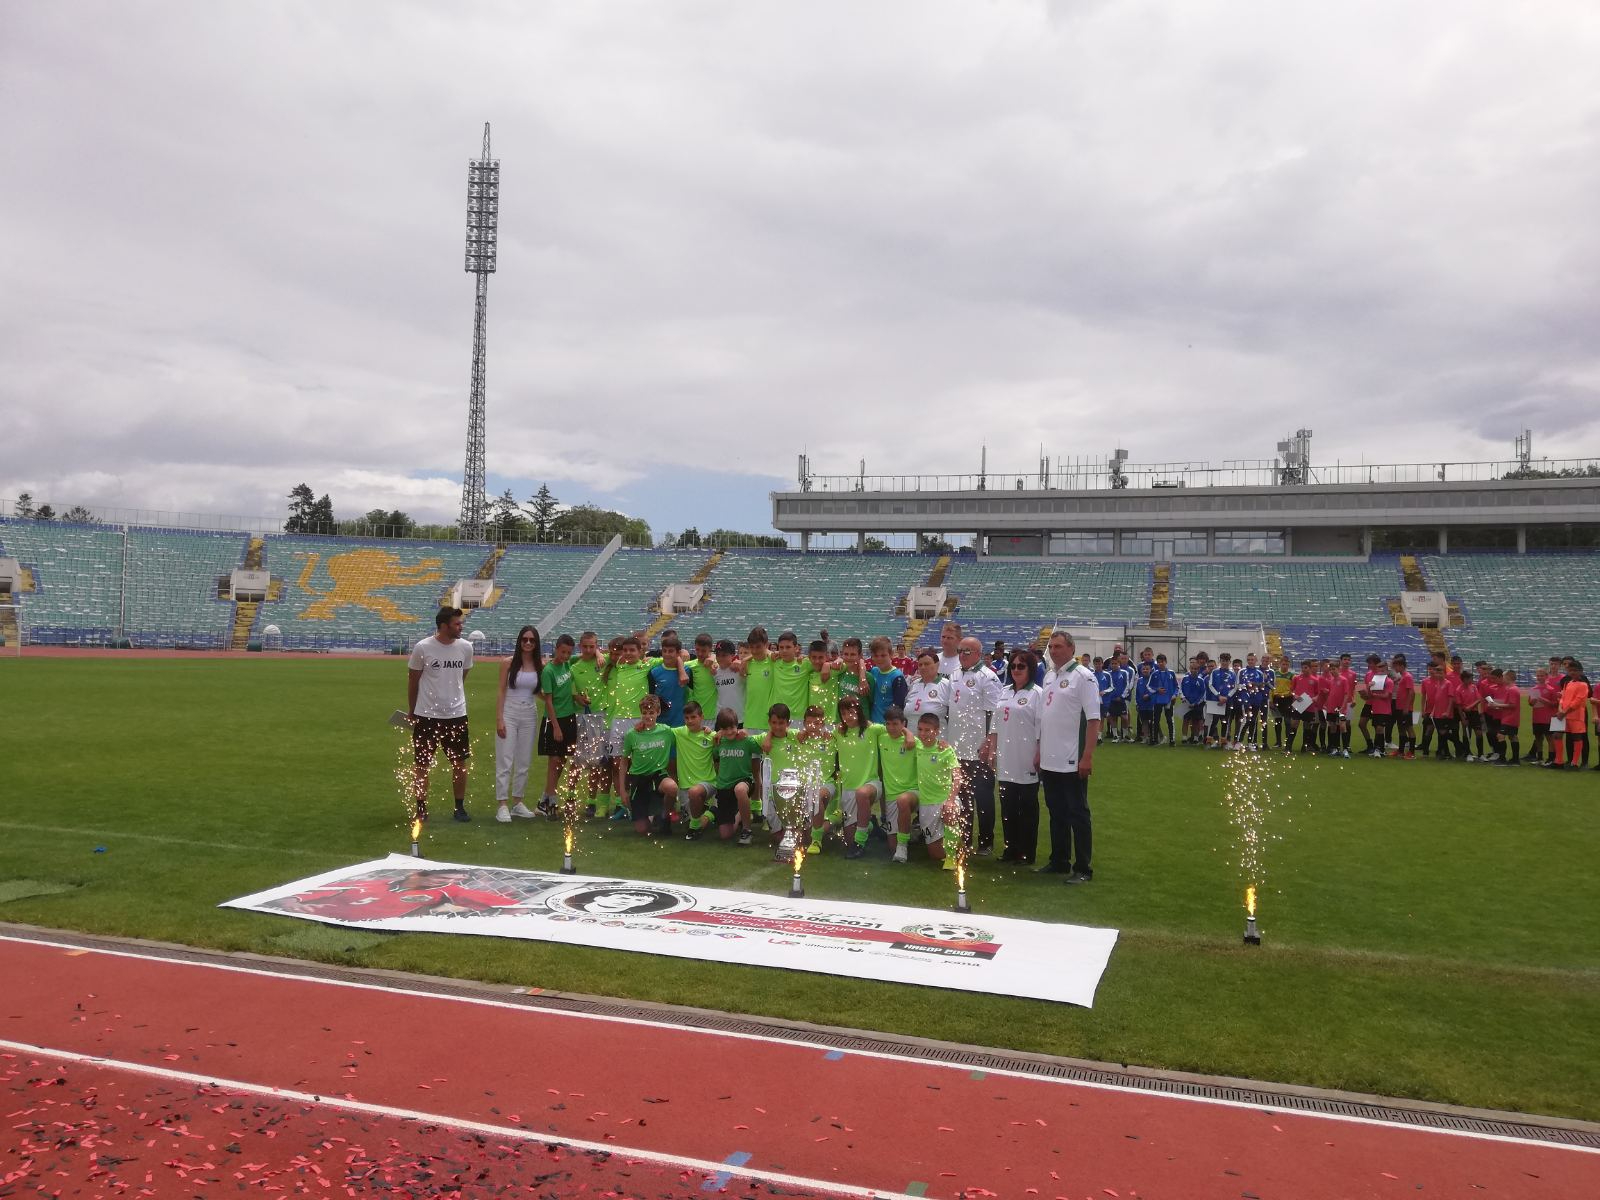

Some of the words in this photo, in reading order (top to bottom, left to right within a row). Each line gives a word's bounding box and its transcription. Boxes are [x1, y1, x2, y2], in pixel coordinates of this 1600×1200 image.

[442, 660, 463, 669] JAKO
[720, 677, 735, 686] JAKO
[1046, 692, 1054, 706] 5
[914, 699, 922, 712] 5
[1003, 707, 1010, 722] 5
[726, 749, 744, 758] JAKO
[709, 905, 754, 915] 17.06
[779, 914, 883, 929] 20.06.2021
[904, 944, 943, 953] НАБОР
